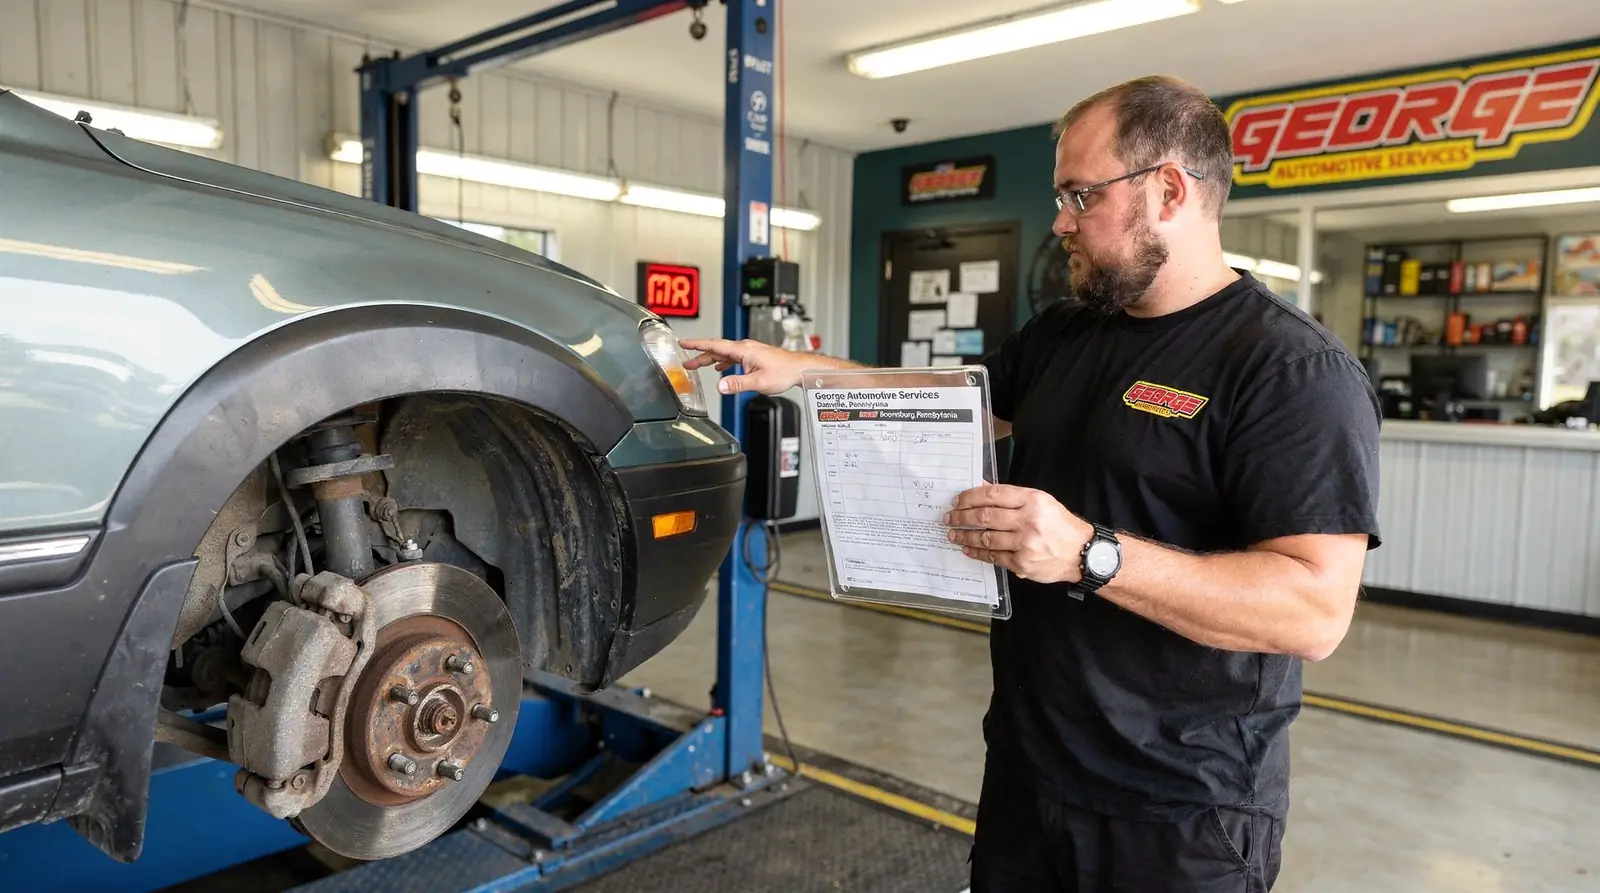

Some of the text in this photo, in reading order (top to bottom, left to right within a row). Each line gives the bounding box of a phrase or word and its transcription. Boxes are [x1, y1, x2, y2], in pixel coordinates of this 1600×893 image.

[1231, 60, 1599, 172] GEORGE
[1276, 146, 1470, 180] AUTOMOTIVE SERVICES
[815, 390, 940, 402] George Automotive Services
[1125, 383, 1204, 415] GEORGE
